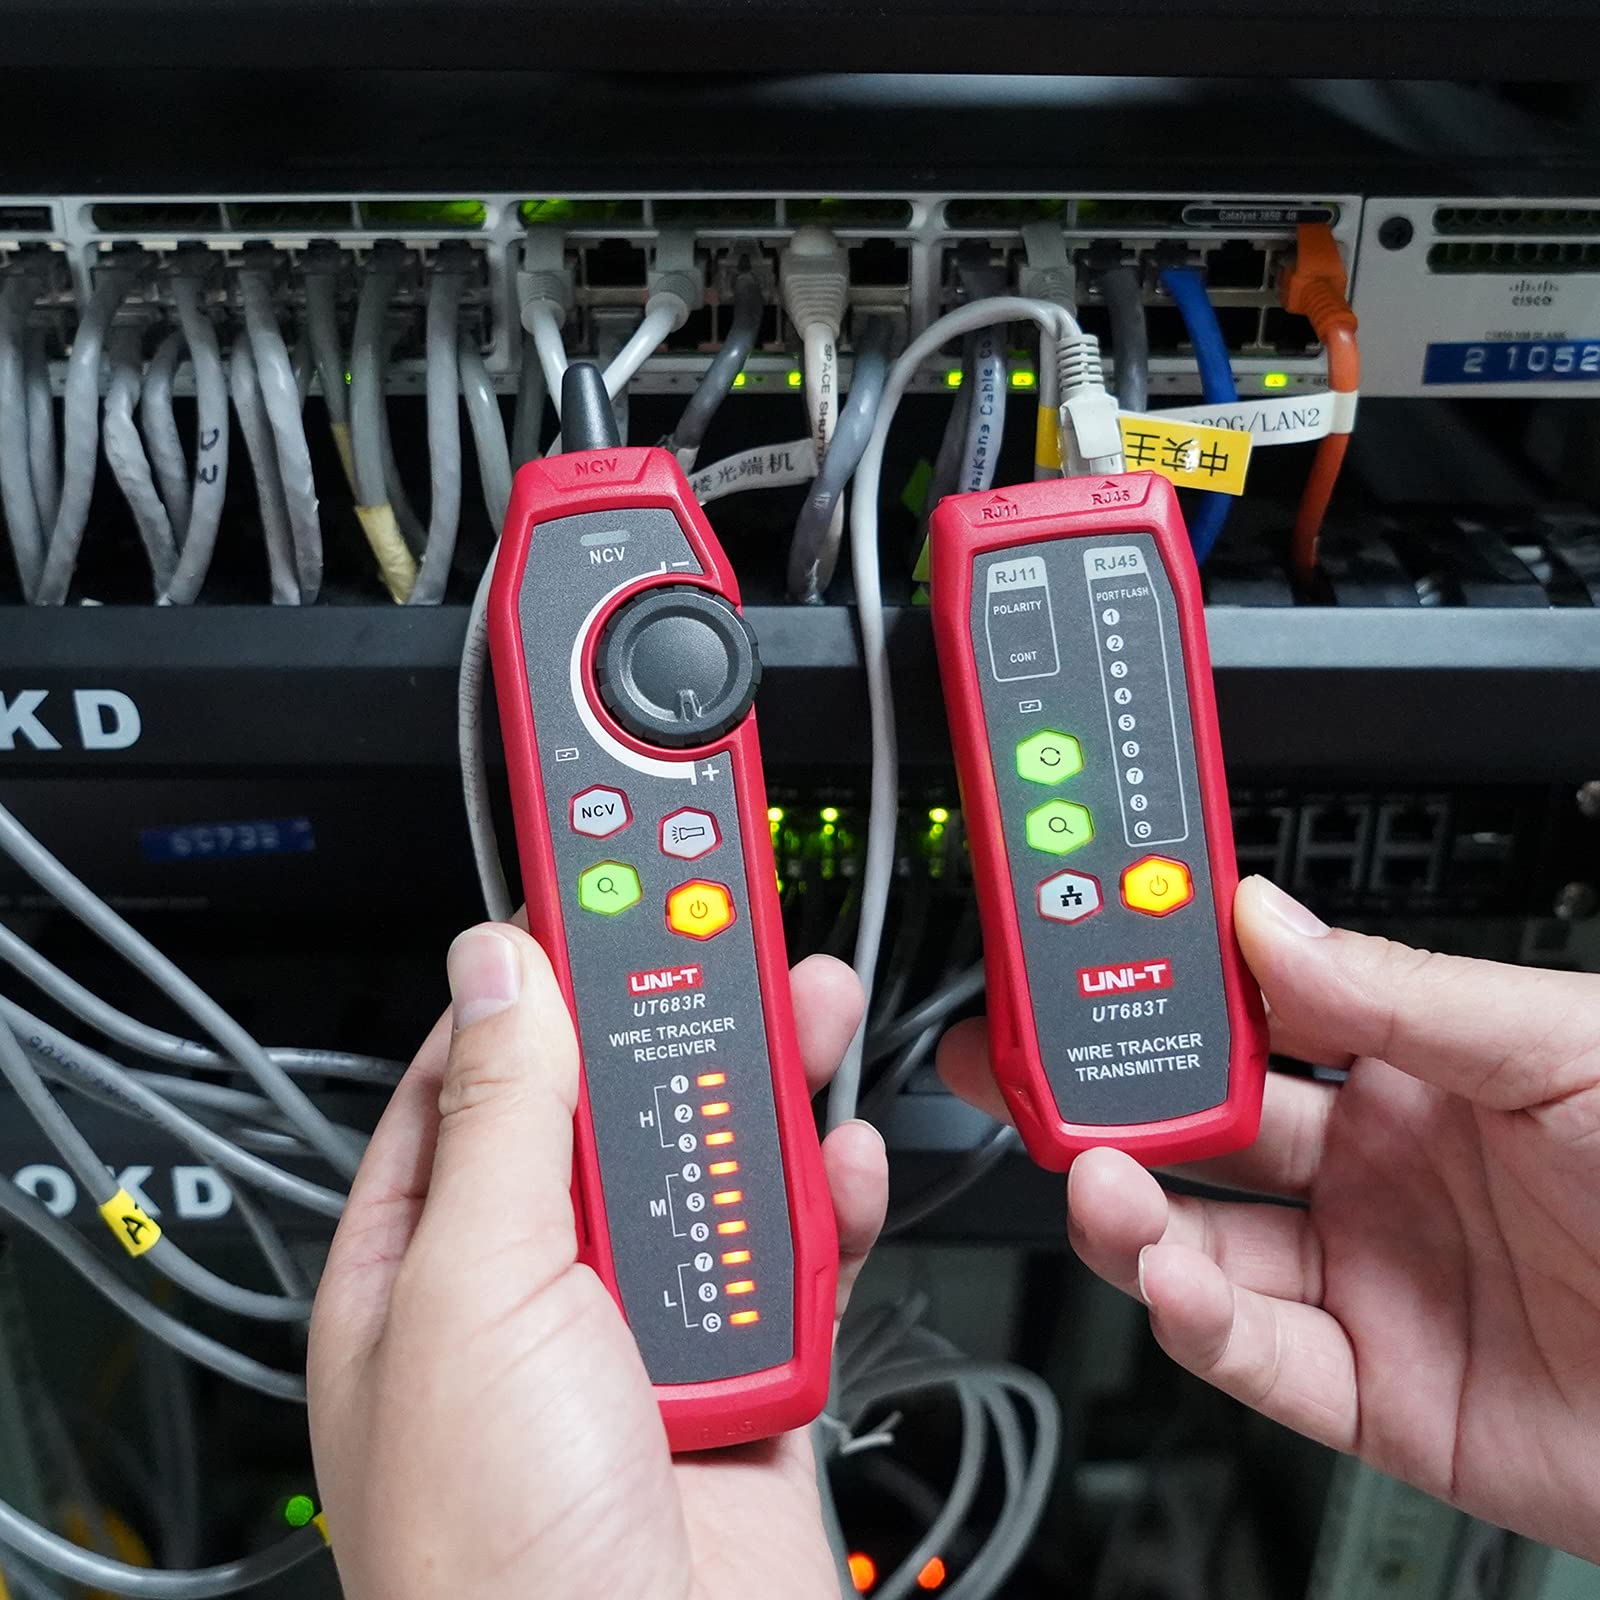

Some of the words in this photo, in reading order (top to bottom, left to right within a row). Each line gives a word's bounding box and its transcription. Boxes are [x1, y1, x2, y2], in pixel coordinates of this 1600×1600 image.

[1511, 296, 1552, 306] cisco
[1463, 347, 1485, 373] 2
[821, 343, 833, 395] SPACE
[980, 368, 994, 416] Cable
[574, 458, 618, 476] NCV
[1092, 490, 1130, 506] RJ45
[982, 504, 1019, 520] RJ11
[590, 547, 625, 565] NCV
[1095, 554, 1138, 571] RJ45
[995, 567, 1037, 584] RJ11
[1096, 589, 1121, 601] PORT
[1121, 586, 1149, 599] FLASH
[993, 600, 1042, 615] POLARITY
[1105, 610, 1117, 624] 1
[1109, 636, 1121, 650] 2
[1010, 651, 1037, 664] CONT
[1113, 662, 1125, 676] 3
[1117, 689, 1129, 703] 4
[1121, 716, 1133, 730] 5
[1125, 742, 1137, 756] 6
[1129, 769, 1141, 783] 7
[582, 803, 615, 819] NCV
[1133, 796, 1145, 810] 8
[1137, 822, 1149, 836] G
[631, 968, 698, 992] UNI-T
[1082, 964, 1166, 992] UNI-T
[633, 994, 706, 1017] UT683R
[1092, 999, 1168, 1022] UT683T
[608, 1028, 652, 1048] WIRE
[656, 1016, 736, 1041] TRACKER
[634, 1038, 717, 1063] RECEIVER
[1067, 1043, 1114, 1063] WIRE
[1117, 1033, 1203, 1057] TRACKER
[1075, 1054, 1201, 1082] TRANSMITTER
[673, 1076, 686, 1092] 1
[640, 1110, 654, 1128] H
[677, 1106, 690, 1120] 2
[681, 1136, 694, 1150] 3
[685, 1165, 698, 1180] 4
[650, 1199, 667, 1217] M
[689, 1195, 702, 1210] 5
[694, 1224, 706, 1240] 6
[698, 1254, 710, 1270] 7
[664, 1290, 677, 1307] L
[702, 1285, 714, 1300] 8
[706, 1315, 718, 1330] G
